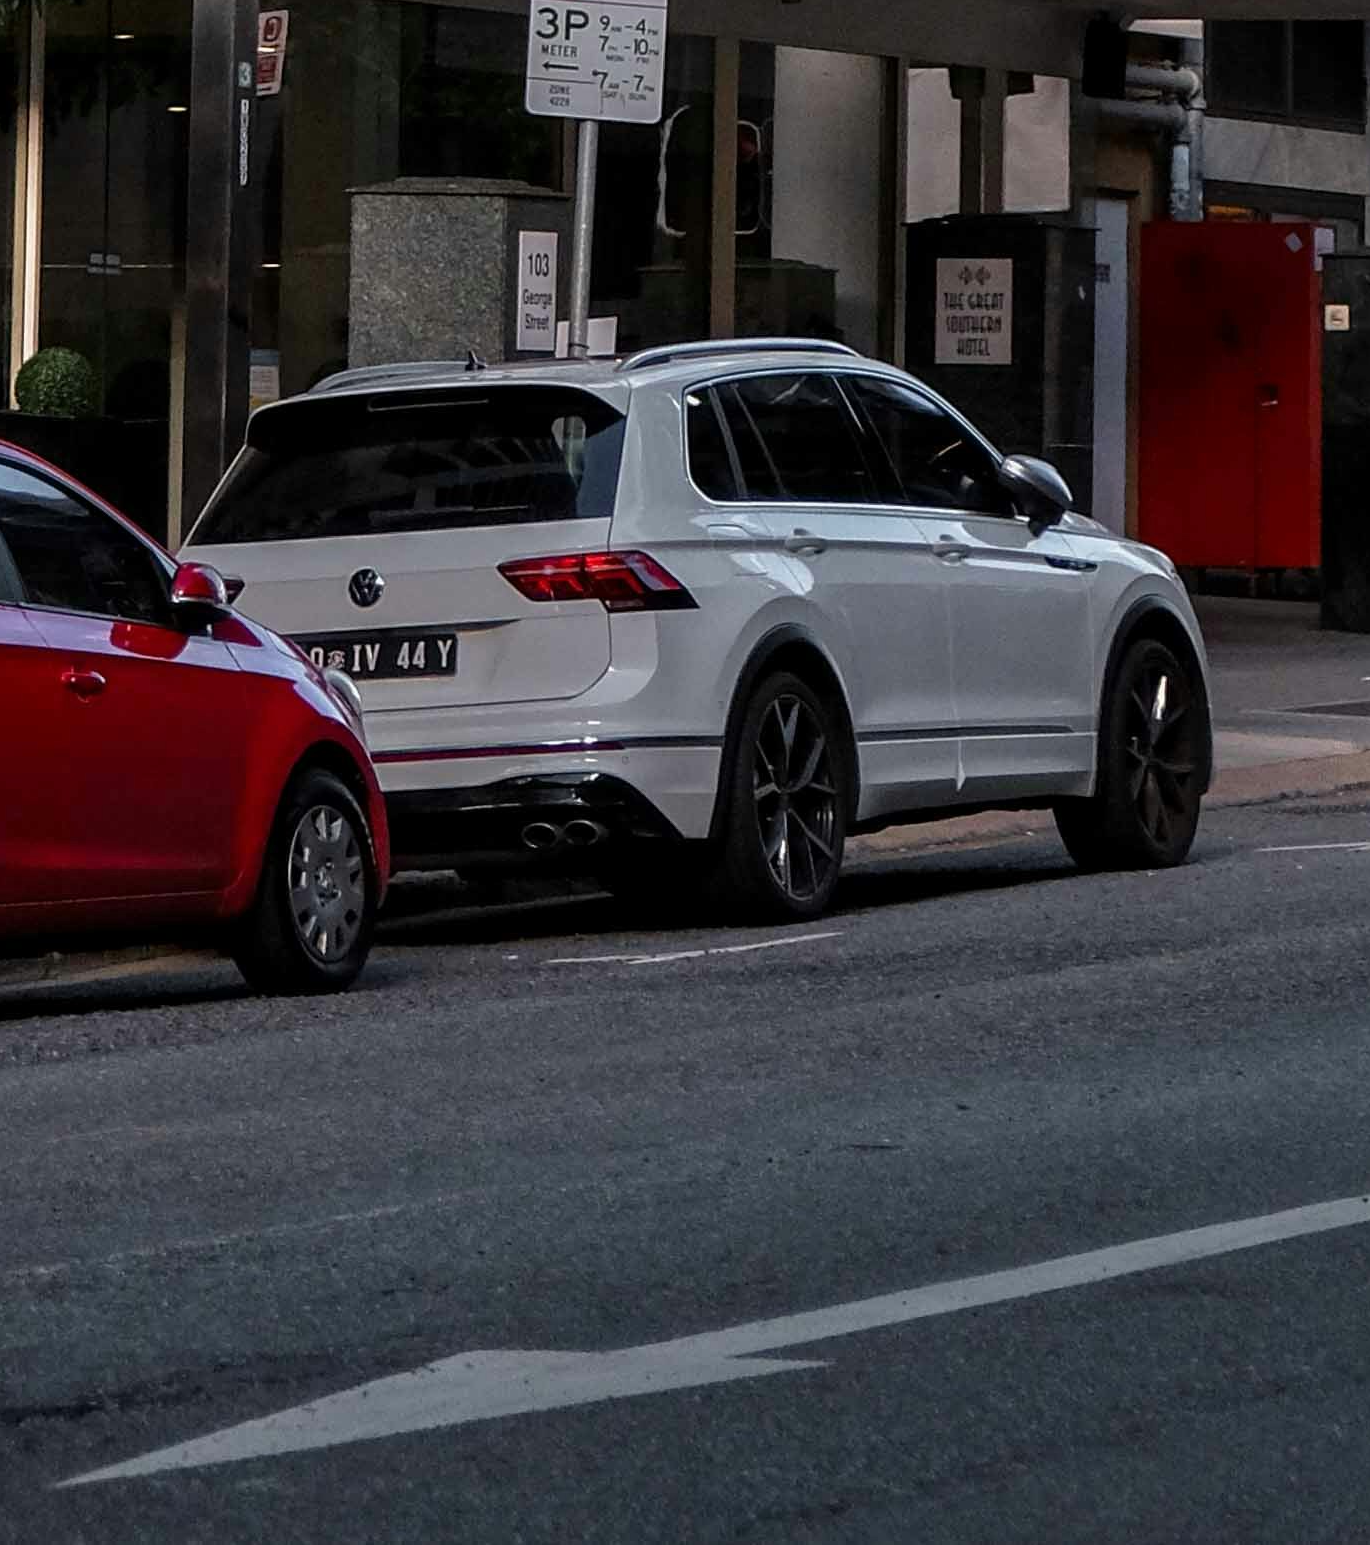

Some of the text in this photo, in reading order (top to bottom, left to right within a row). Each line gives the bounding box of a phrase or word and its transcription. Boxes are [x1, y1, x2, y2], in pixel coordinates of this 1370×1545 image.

[535, 7, 590, 41] 3P
[541, 44, 578, 58] METER
[527, 252, 550, 278] 103
[522, 288, 553, 310] George
[942, 292, 1005, 311] THE GREAT
[525, 313, 550, 331] Street
[946, 314, 1003, 334] SOUTHERN
[956, 337, 991, 357] HOTEL
[351, 643, 381, 673] IV
[396, 640, 426, 670] 44
[437, 638, 453, 668] Y
